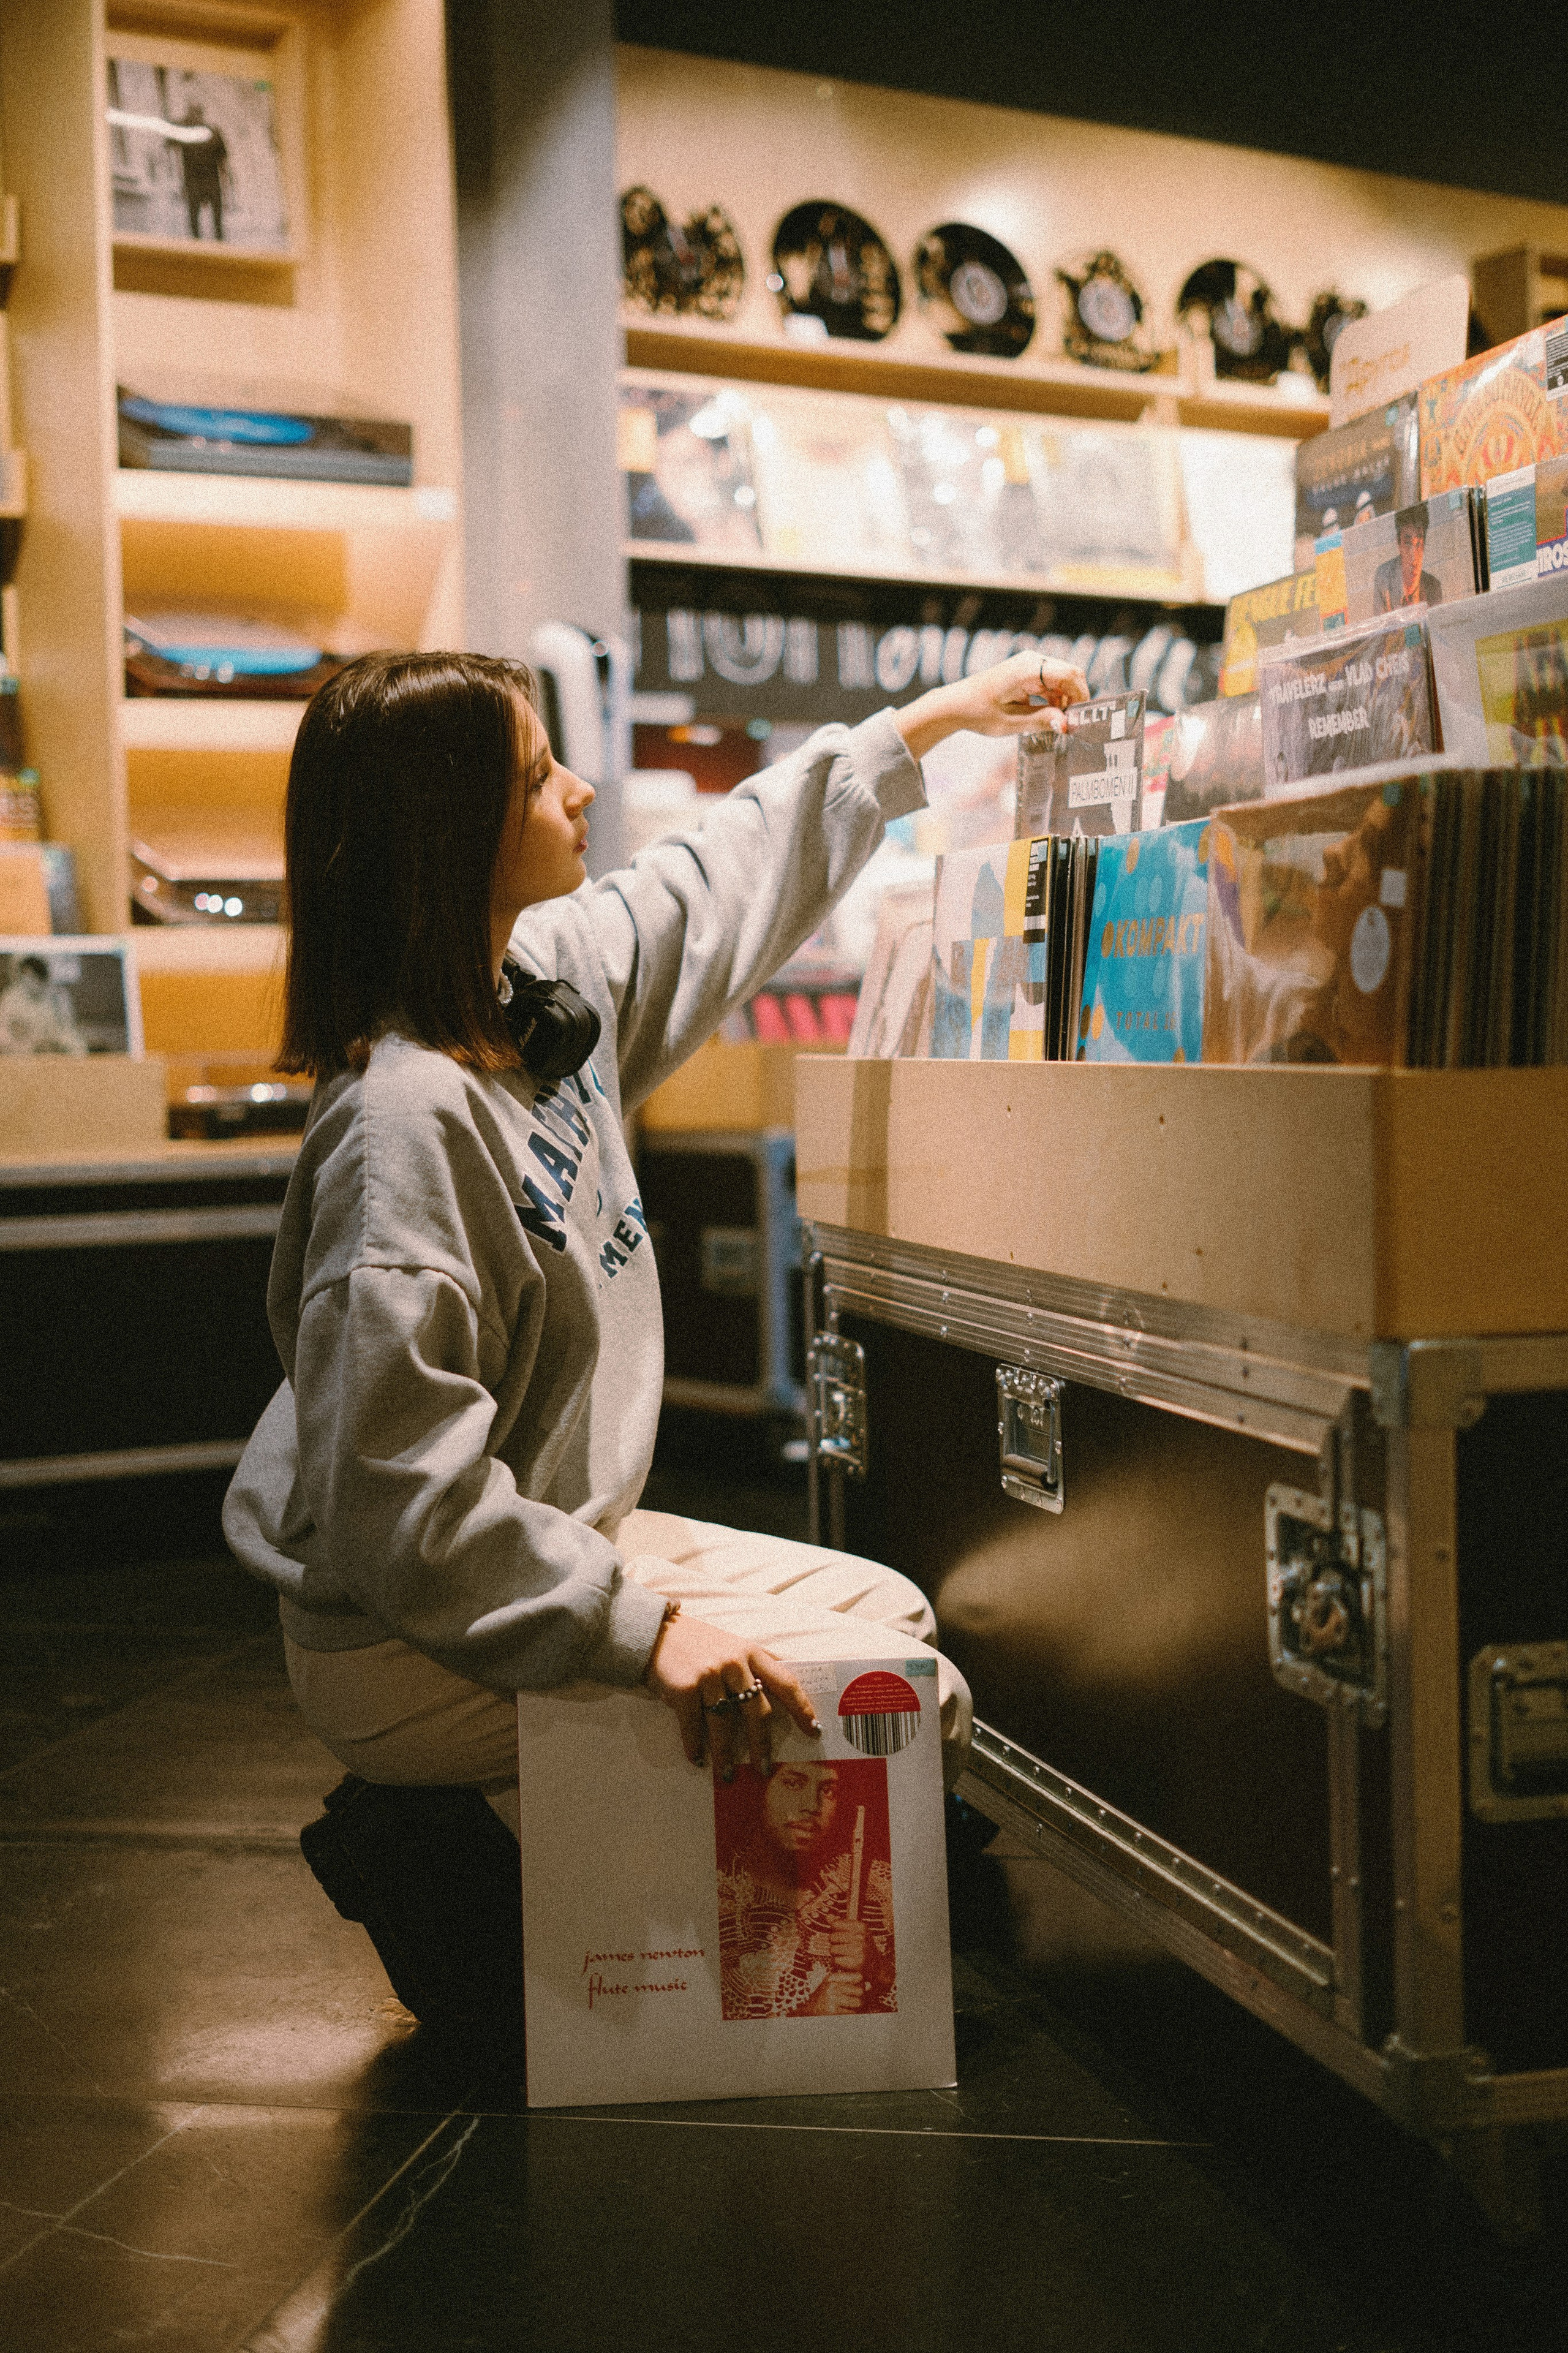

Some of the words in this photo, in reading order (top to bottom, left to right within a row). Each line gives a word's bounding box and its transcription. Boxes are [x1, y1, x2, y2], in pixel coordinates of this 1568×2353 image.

[1308, 706, 1370, 740] REMEMBER
[1071, 776, 1125, 802] PALMBOMEN
[1113, 912, 1205, 958] KOMPAKT
[1116, 1011, 1158, 1030] TOTAL
[581, 1951, 635, 1976] james
[640, 1948, 704, 1960] newton
[587, 1972, 628, 2010] flute
[635, 1978, 687, 1992] music
